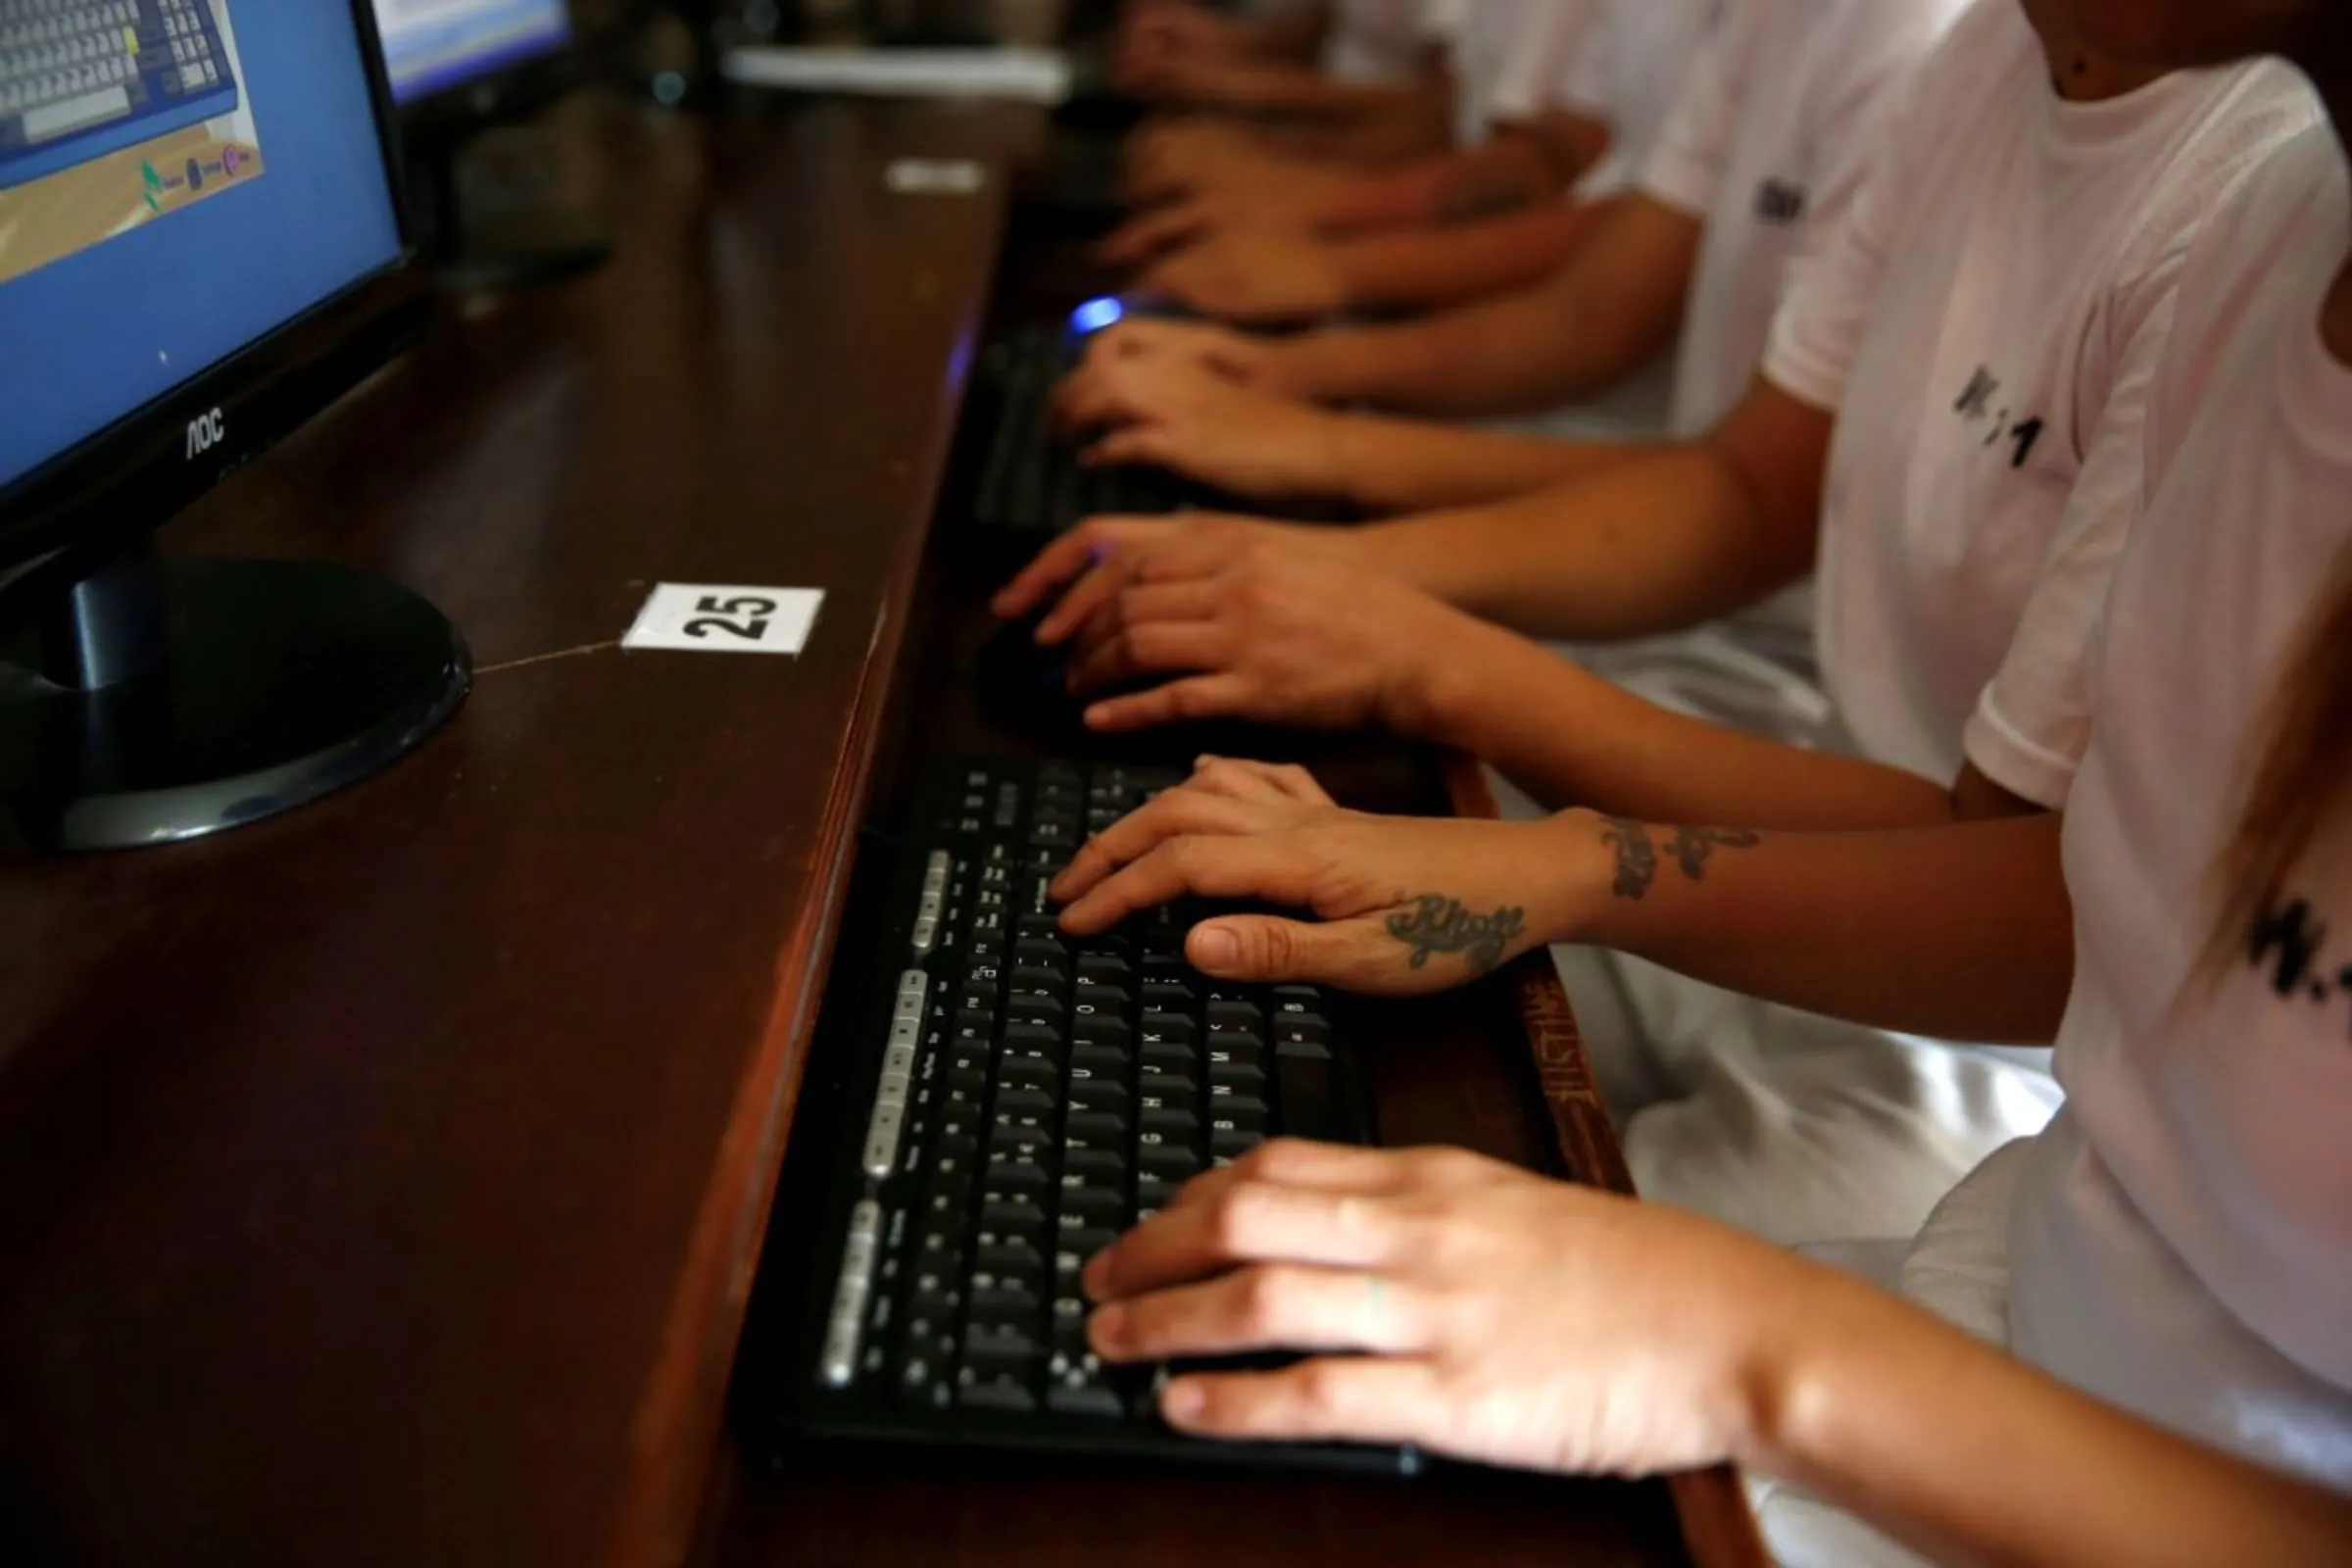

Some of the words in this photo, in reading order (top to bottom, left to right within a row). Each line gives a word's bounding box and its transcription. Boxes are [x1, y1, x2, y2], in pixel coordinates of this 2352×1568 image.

[186, 407, 224, 460] AOC
[682, 595, 777, 640] 25
[1076, 976, 1096, 986] P
[1075, 1004, 1096, 1015] O
[1142, 1033, 1162, 1043] K
[1209, 1051, 1231, 1063] M
[1071, 1067, 1093, 1079] U
[1141, 1064, 1162, 1075] J
[1211, 1084, 1233, 1097] N
[1068, 1100, 1089, 1111] Y
[1142, 1096, 1162, 1108] H
[1211, 1119, 1236, 1131] B
[1064, 1137, 1087, 1149] T
[1139, 1132, 1163, 1146] G
[1137, 1170, 1160, 1185] F
